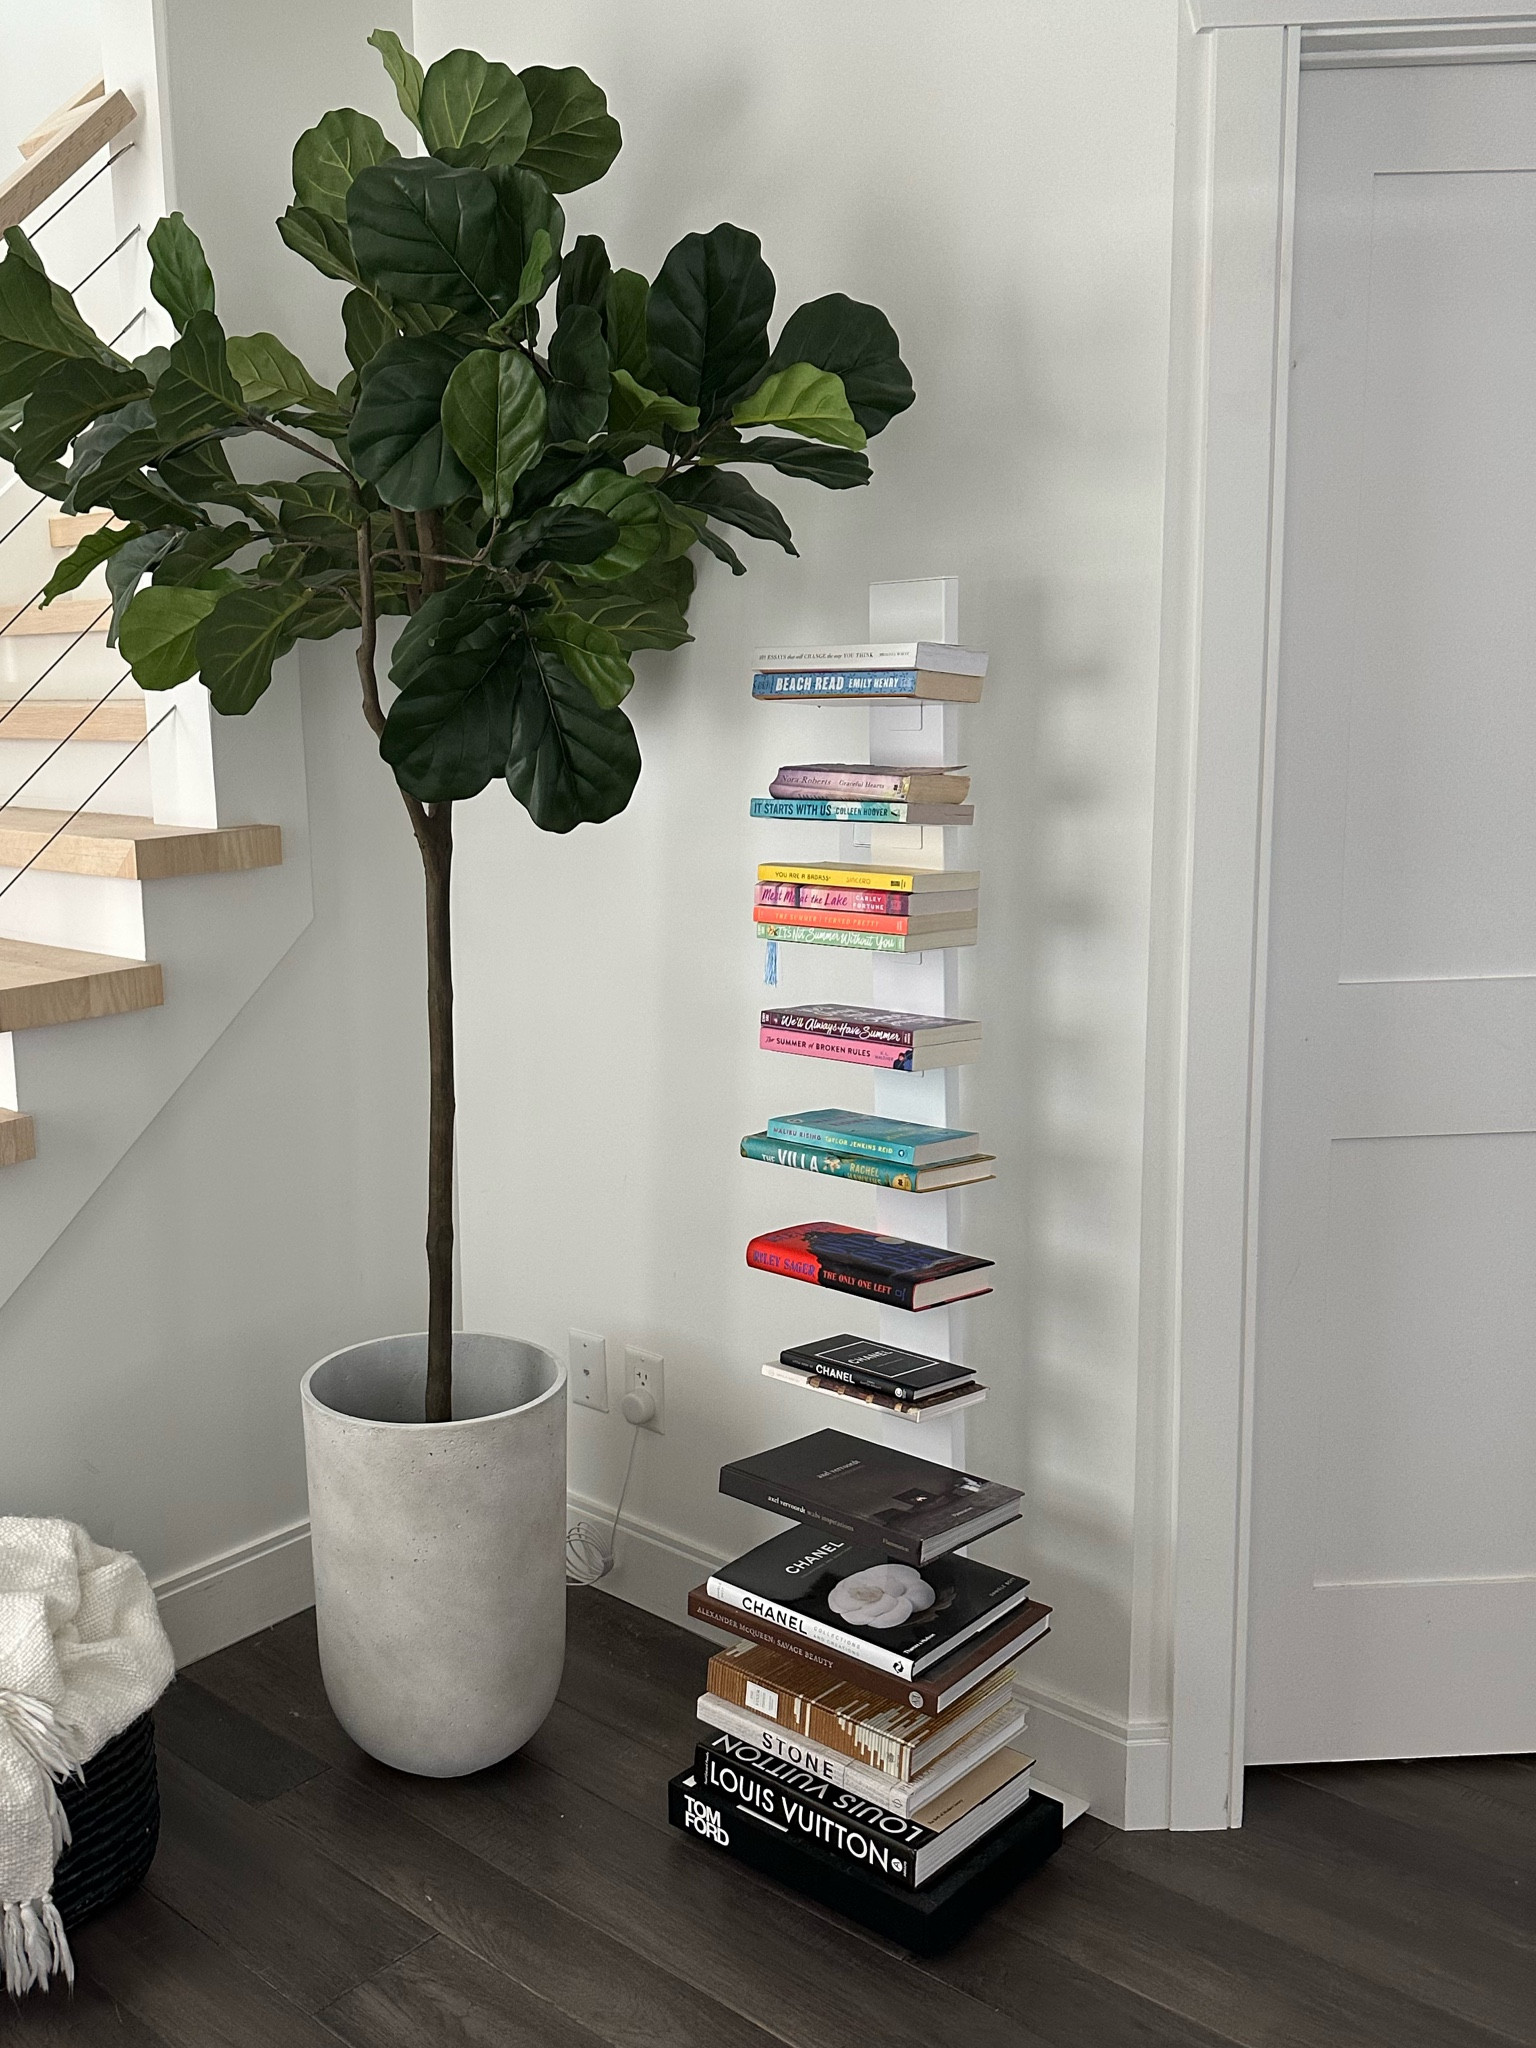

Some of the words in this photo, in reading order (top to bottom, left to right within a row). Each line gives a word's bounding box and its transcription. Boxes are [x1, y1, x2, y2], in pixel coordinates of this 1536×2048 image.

[776, 677, 812, 691] BEACH
[814, 676, 844, 691] READ
[848, 678, 872, 688] EMILY
[873, 678, 900, 688] HENRY
[782, 775, 798, 783] Nora
[802, 776, 832, 786] Roberts
[838, 780, 864, 788] Graceful
[754, 802, 762, 814] IT
[764, 803, 794, 815] STARTS
[796, 804, 818, 816] WITH
[820, 804, 832, 816] US
[836, 807, 862, 816] COLLEEN
[863, 808, 888, 816] HOOVER
[846, 876, 872, 885] SINCERO
[800, 894, 808, 902] at
[810, 894, 823, 904] the
[824, 893, 848, 906] Lake
[852, 902, 884, 910] FORTUNE
[855, 895, 882, 903] CARLEY
[790, 914, 817, 922] SUMMER
[852, 919, 879, 927] PRETTY
[792, 926, 805, 941] Not
[806, 928, 840, 942] Summer
[840, 932, 874, 946] Without
[875, 936, 894, 950] You
[781, 1014, 804, 1028] We'll
[804, 1018, 838, 1035] Always
[838, 1022, 861, 1037] Have
[859, 1026, 900, 1042] Summer
[776, 1038, 806, 1048] SUMMER
[816, 1043, 846, 1054] BROKEN
[847, 1047, 871, 1058] RULES
[773, 1127, 798, 1137] MALIBU
[800, 1131, 822, 1141] RISING
[825, 1136, 848, 1146] TAYLOR
[849, 1141, 876, 1151] JENKINS
[877, 1146, 894, 1154] REID
[761, 1154, 776, 1162] THE
[850, 1162, 880, 1178] RACHEL
[753, 1250, 781, 1267] RILEY
[783, 1258, 816, 1276] SAGER
[823, 1270, 837, 1280] THE
[838, 1274, 856, 1286] ONLY
[857, 1279, 872, 1290] ONE
[873, 1284, 892, 1295] LEFT
[848, 1350, 894, 1364] CHANEL
[816, 1364, 856, 1384] CHANEL
[768, 1496, 780, 1504] axel
[780, 1500, 806, 1514] vervoordt
[785, 1540, 844, 1575] CHANEL
[742, 1597, 808, 1635] CHANEL
[696, 1606, 738, 1629] ALEXANDER
[776, 1640, 803, 1656] SAVAGE
[804, 1652, 834, 1669] BEAUTY
[813, 1626, 861, 1650] COLLECTIONS
[826, 1639, 860, 1657] CREATIONS
[762, 1732, 834, 1780] STONE
[712, 1734, 830, 1800] VUITTON
[684, 1794, 721, 1828] TOM
[710, 1760, 774, 1812] LOUIS
[782, 1796, 889, 1873] VUITTON
[832, 1794, 924, 1842] LOUIS
[685, 1810, 730, 1847] FORD
